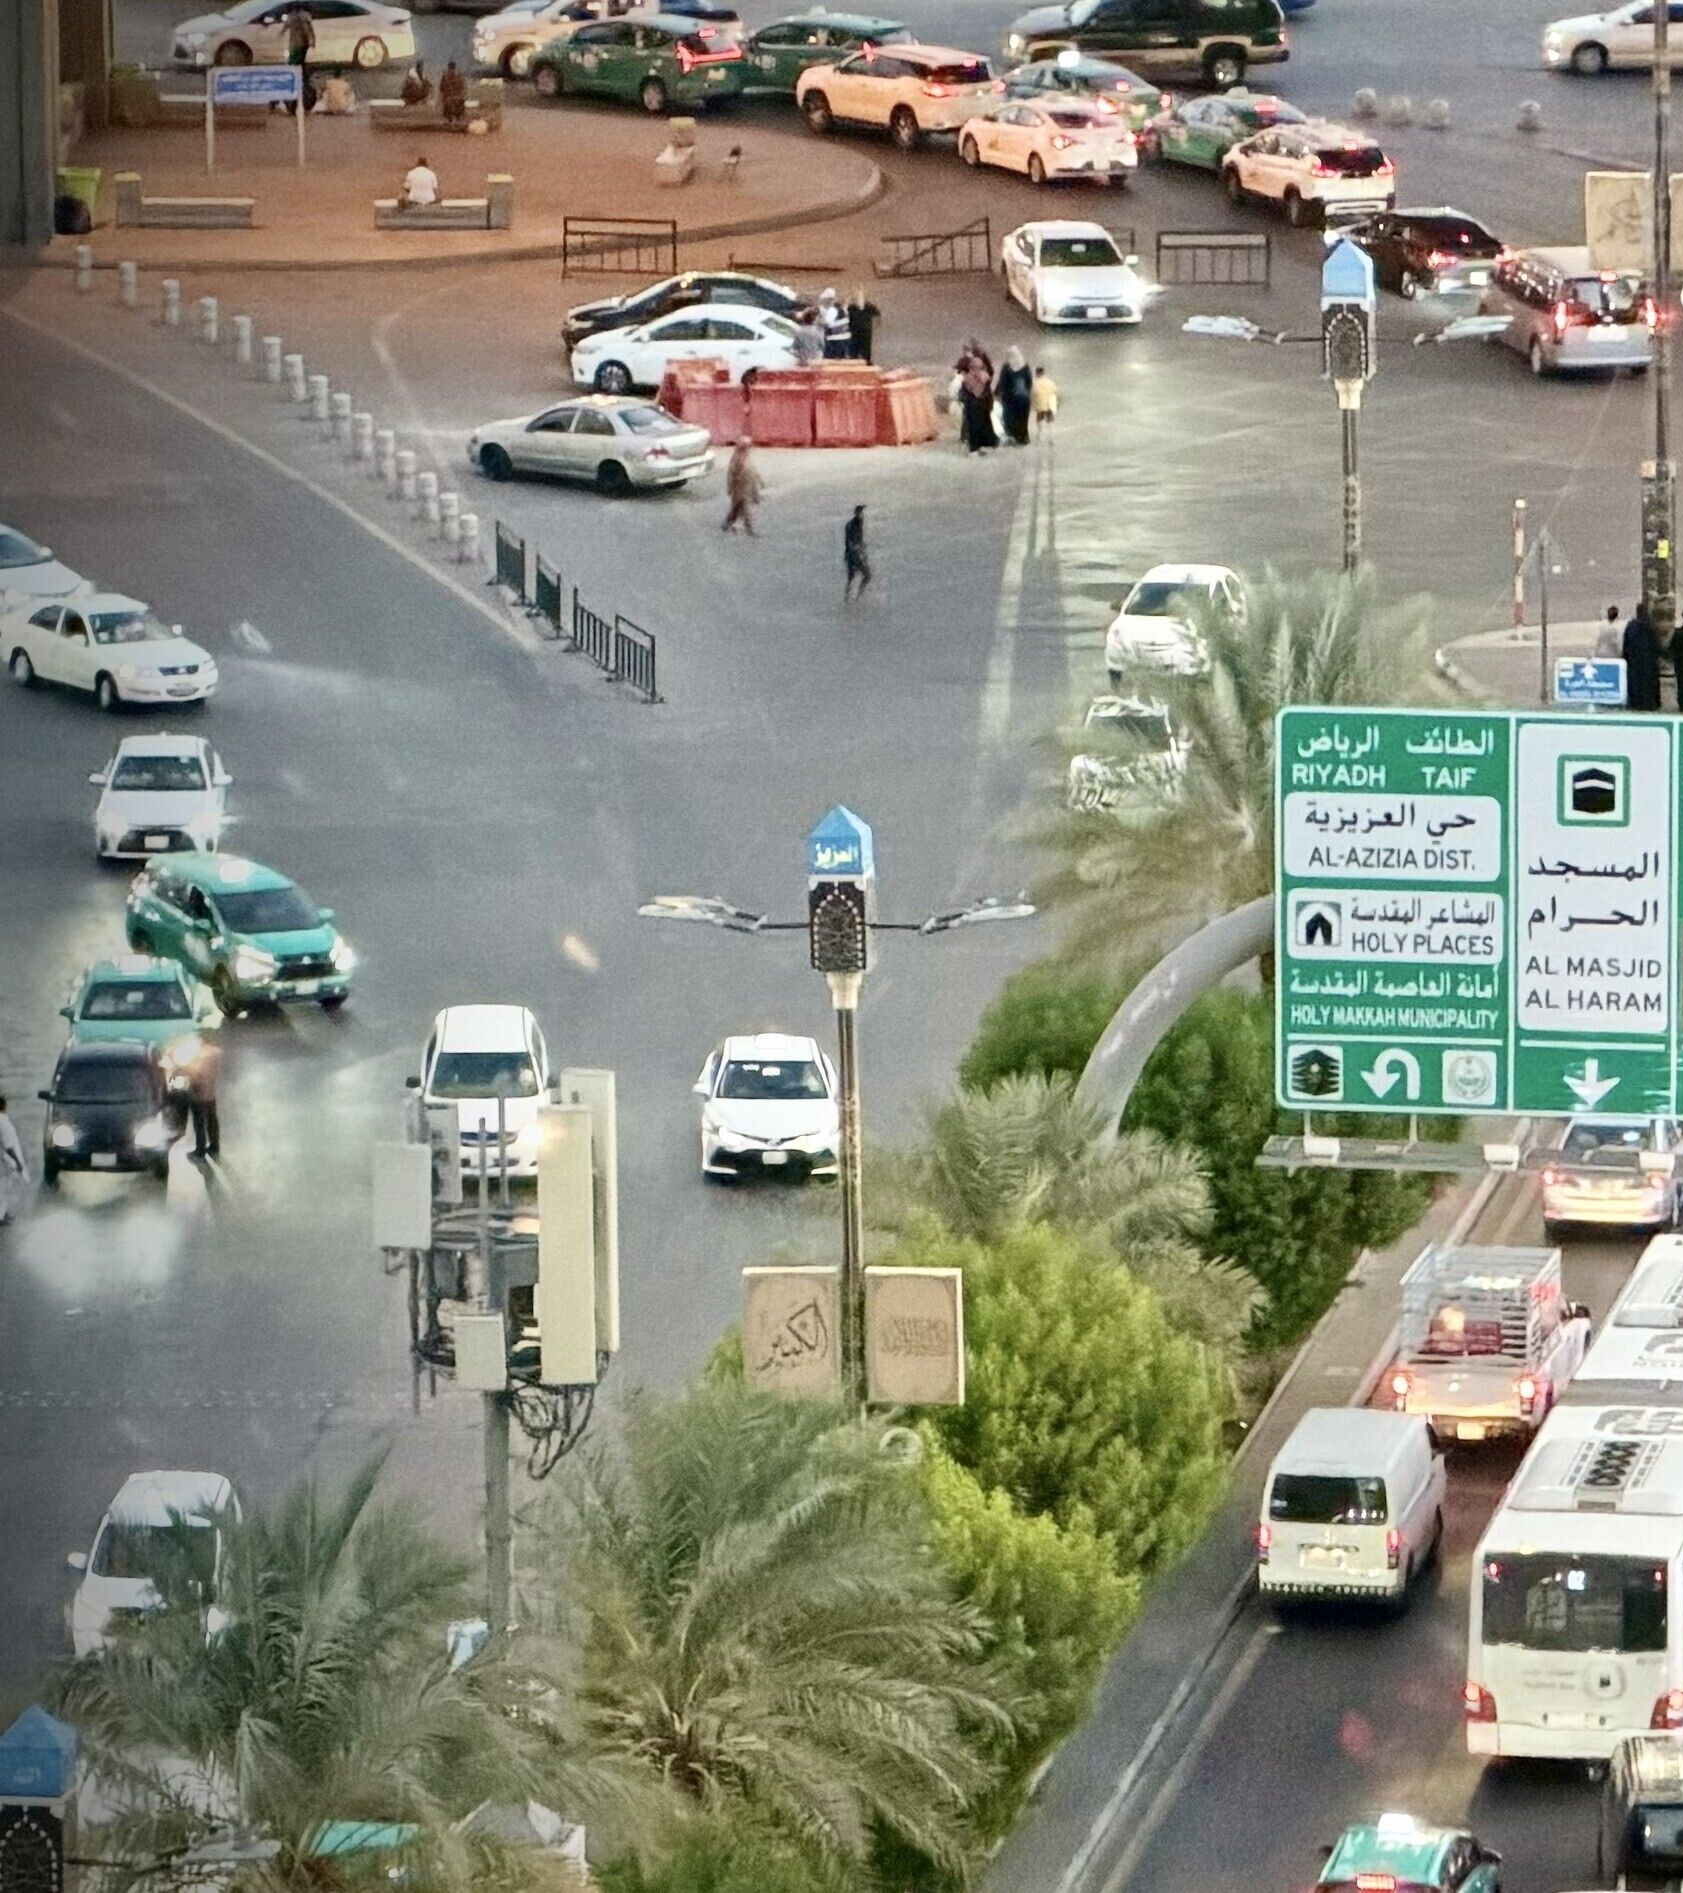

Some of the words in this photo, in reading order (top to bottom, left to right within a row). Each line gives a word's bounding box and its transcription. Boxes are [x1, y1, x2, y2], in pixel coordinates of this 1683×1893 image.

[1297, 723, 1379, 759] الرياض
[1405, 726, 1494, 755] الطائف
[1291, 763, 1386, 787] RIYADH
[1421, 766, 1476, 788] TAIF
[1304, 801, 1415, 834] العزيزية
[1427, 813, 1476, 845] حي
[1308, 847, 1418, 869] AL-AZIZIA
[1424, 850, 1475, 871] DIST.
[1528, 851, 1659, 884] المسجد
[1351, 897, 1421, 925] المقدسة
[1427, 898, 1495, 929] المشاعر
[1528, 895, 1659, 940] الحرام
[1352, 932, 1409, 953] HOLY
[1413, 934, 1494, 956] PLACES
[1525, 956, 1559, 975] AL
[1566, 957, 1661, 978] MASJID
[1290, 968, 1368, 998] المقدسة
[1374, 970, 1451, 998] العاصمة
[1525, 988, 1560, 1009] AL
[1567, 989, 1661, 1012] HARAM
[1290, 1005, 1329, 1026] HOLY
[1332, 1006, 1397, 1028] MAKKAH
[1398, 1007, 1499, 1030] MUNICIPALITY
